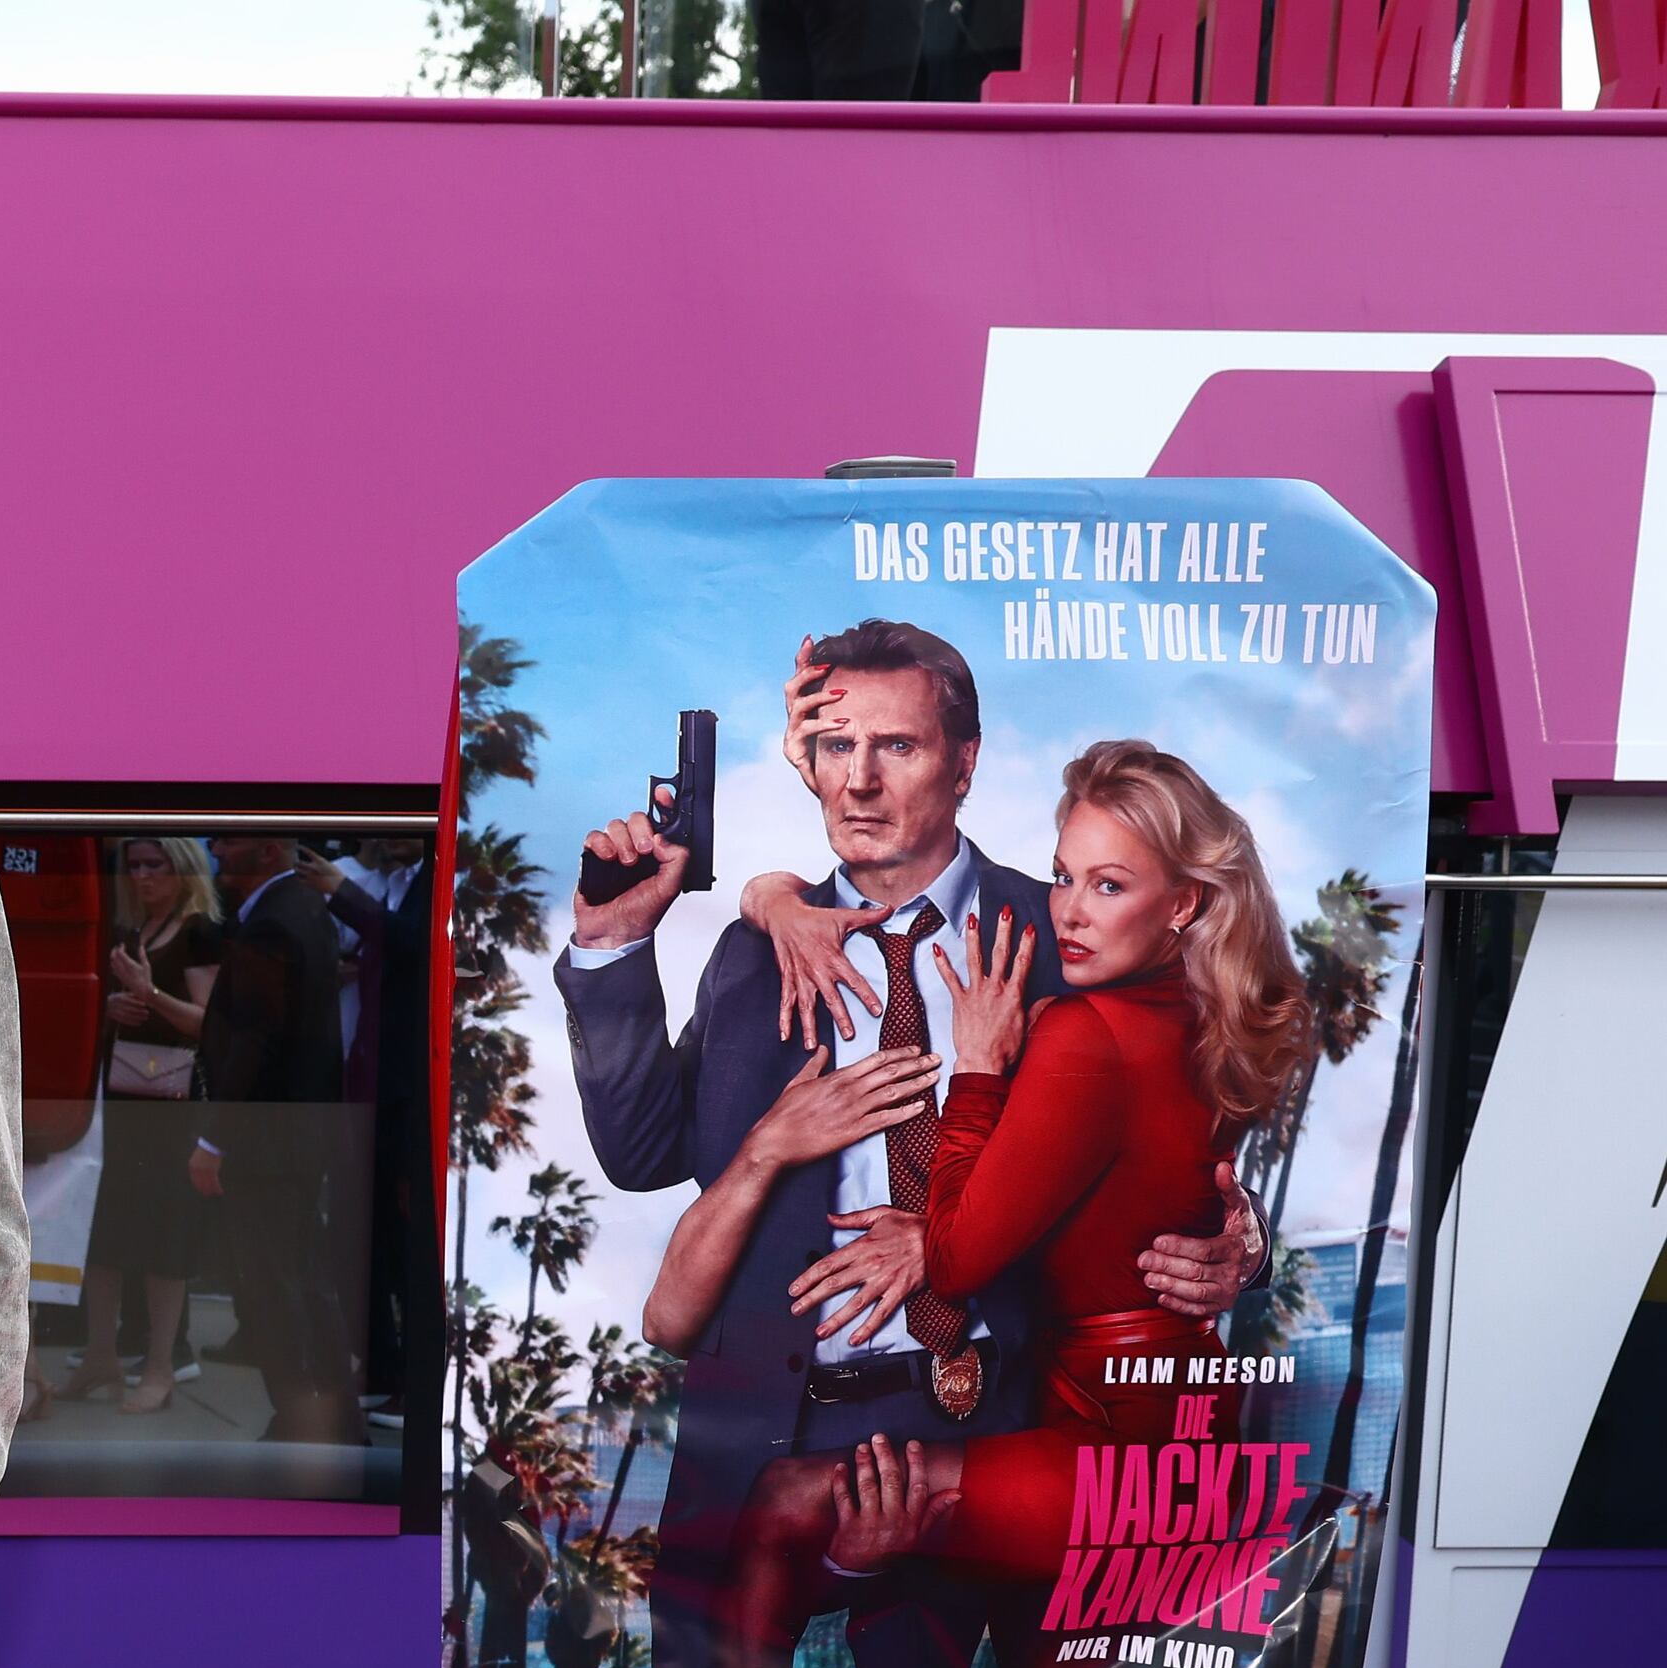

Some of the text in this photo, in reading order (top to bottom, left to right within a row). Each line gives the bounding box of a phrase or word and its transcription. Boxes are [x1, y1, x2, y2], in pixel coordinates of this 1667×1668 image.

[854, 522, 1268, 582] DAS GESETZ HAT ALLE
[1003, 588, 1378, 664] HÄNDE VOLL ZU TUN
[1104, 1355, 1295, 1384] LIAM NEESON
[1173, 1395, 1219, 1440] DIE
[1067, 1442, 1311, 1546] NACKTE
[1040, 1538, 1289, 1637] KANONE
[1056, 1636, 1111, 1662] NUR
[1118, 1635, 1156, 1665] IM
